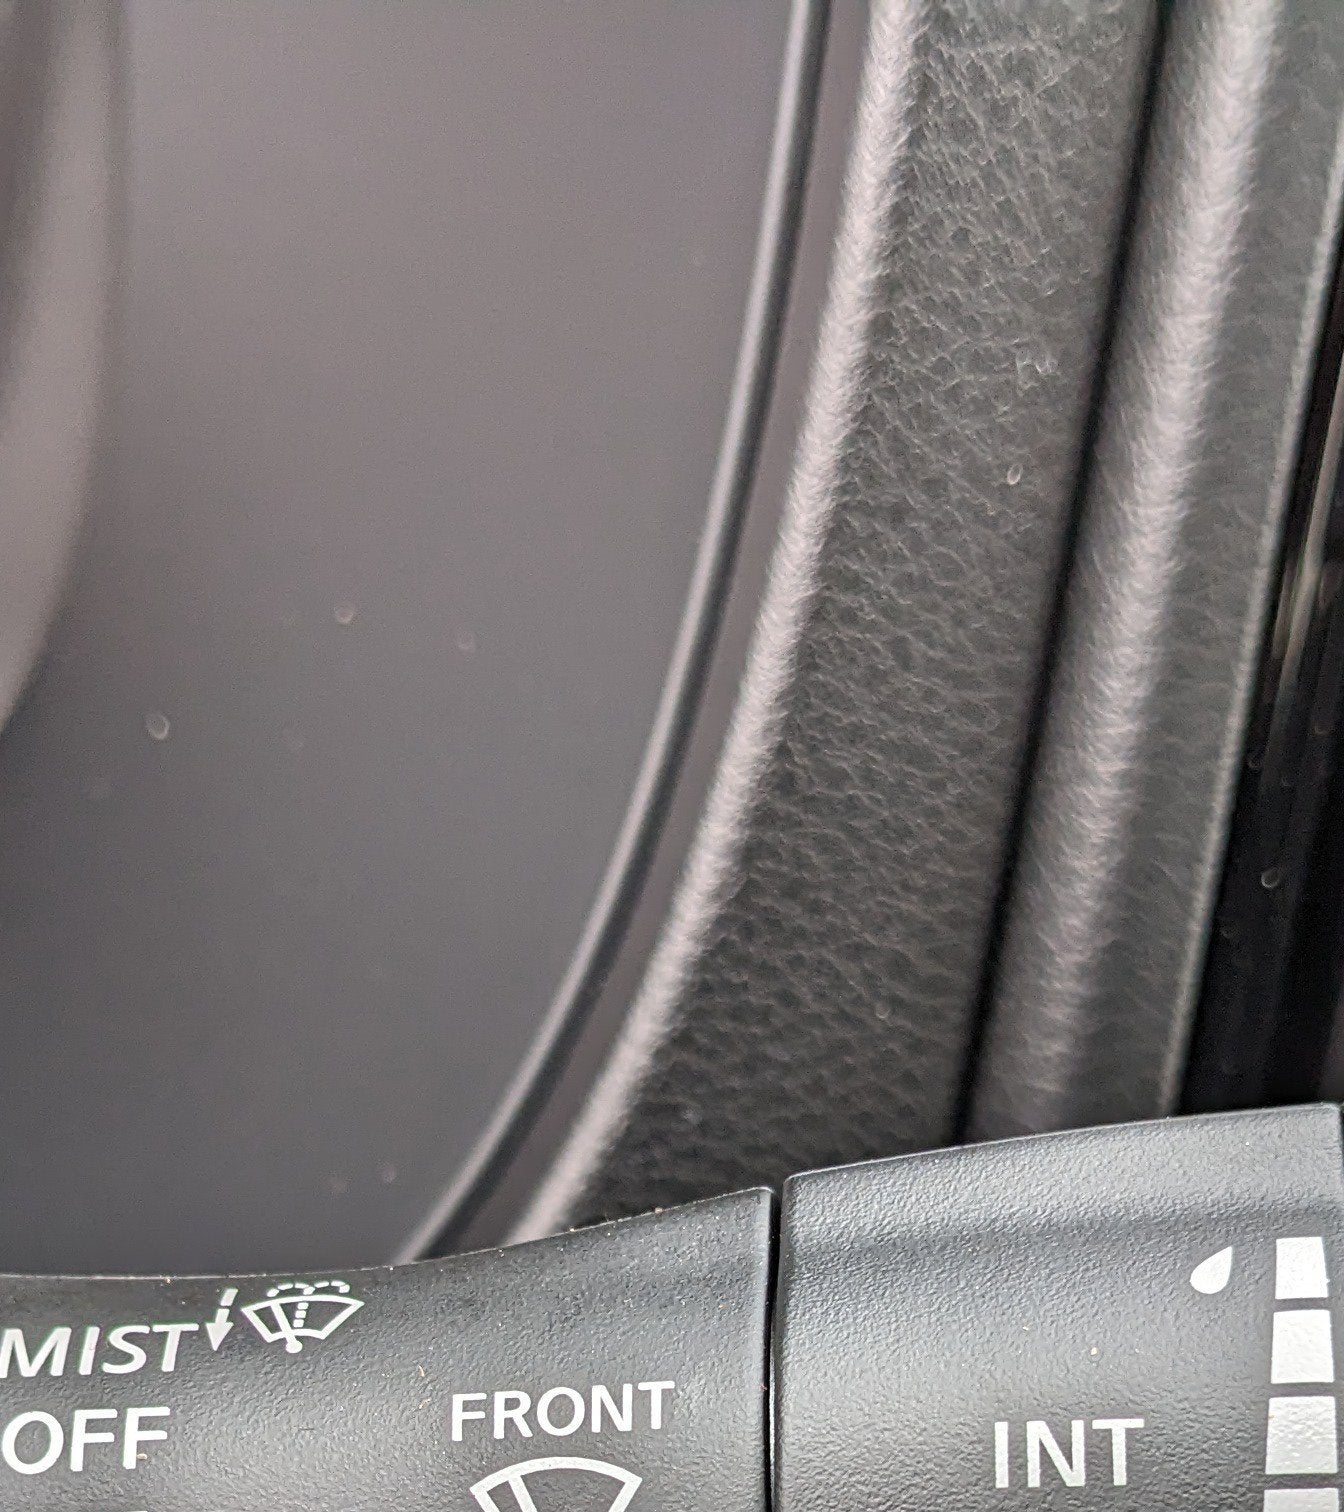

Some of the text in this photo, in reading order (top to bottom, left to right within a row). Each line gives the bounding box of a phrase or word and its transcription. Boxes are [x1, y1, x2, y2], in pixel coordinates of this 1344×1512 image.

[1, 1406, 171, 1475] OFF
[450, 1380, 676, 1442] FRONT
[993, 1418, 1145, 1489] INT
